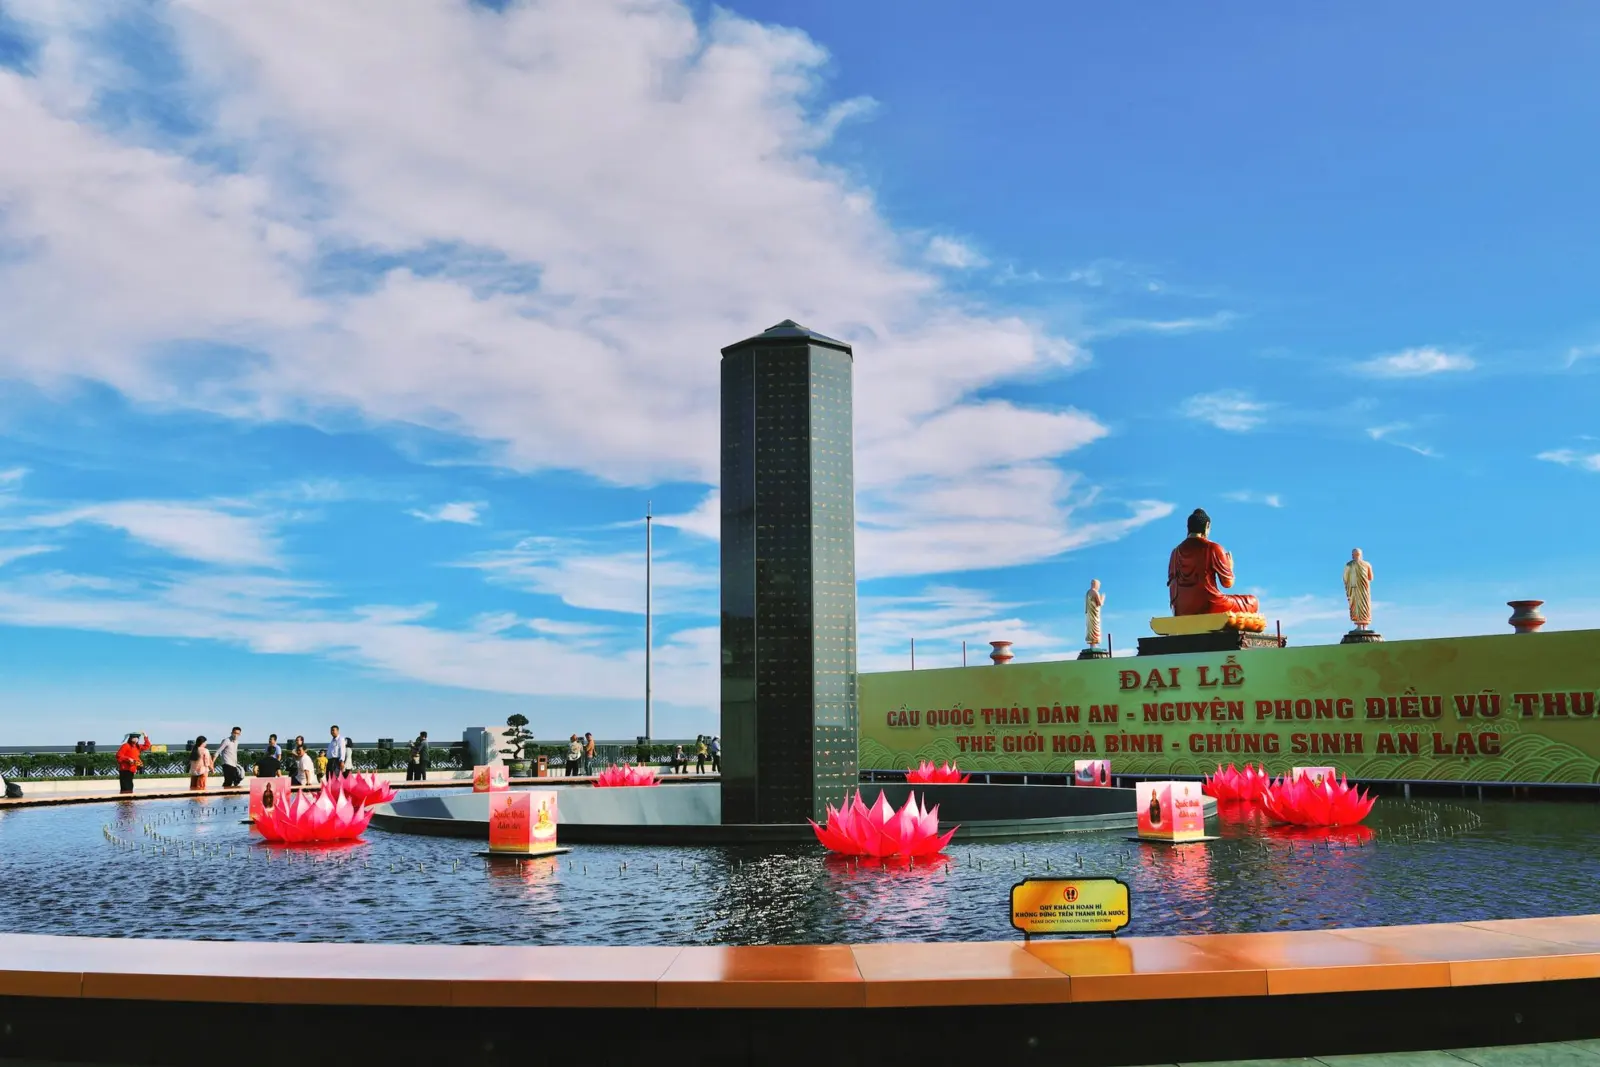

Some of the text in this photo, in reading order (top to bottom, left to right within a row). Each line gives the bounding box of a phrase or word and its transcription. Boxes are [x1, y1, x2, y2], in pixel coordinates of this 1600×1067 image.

[1119, 655, 1245, 694] ĐẠI LỄ
[886, 703, 921, 727] CẦU
[926, 702, 974, 727] QUỐC
[980, 702, 1030, 725] THÁI
[1037, 701, 1080, 724] DÂN
[1088, 704, 1119, 723] AN
[1142, 696, 1245, 726] NGUYỆN
[1255, 697, 1354, 720] PHONG
[1365, 686, 1443, 719] ĐIỀU
[1453, 688, 1501, 718] VŨ
[1513, 691, 1600, 717] THU
[956, 729, 996, 753] THẾ
[1002, 729, 1044, 753] GIỚI
[1052, 730, 1097, 753] HOÀ
[1104, 729, 1164, 753] BÌNH
[1188, 728, 1280, 754] CHÚNG
[1290, 732, 1364, 754] SINH
[1375, 732, 1420, 754] AN
[1432, 732, 1502, 763] LẠC
